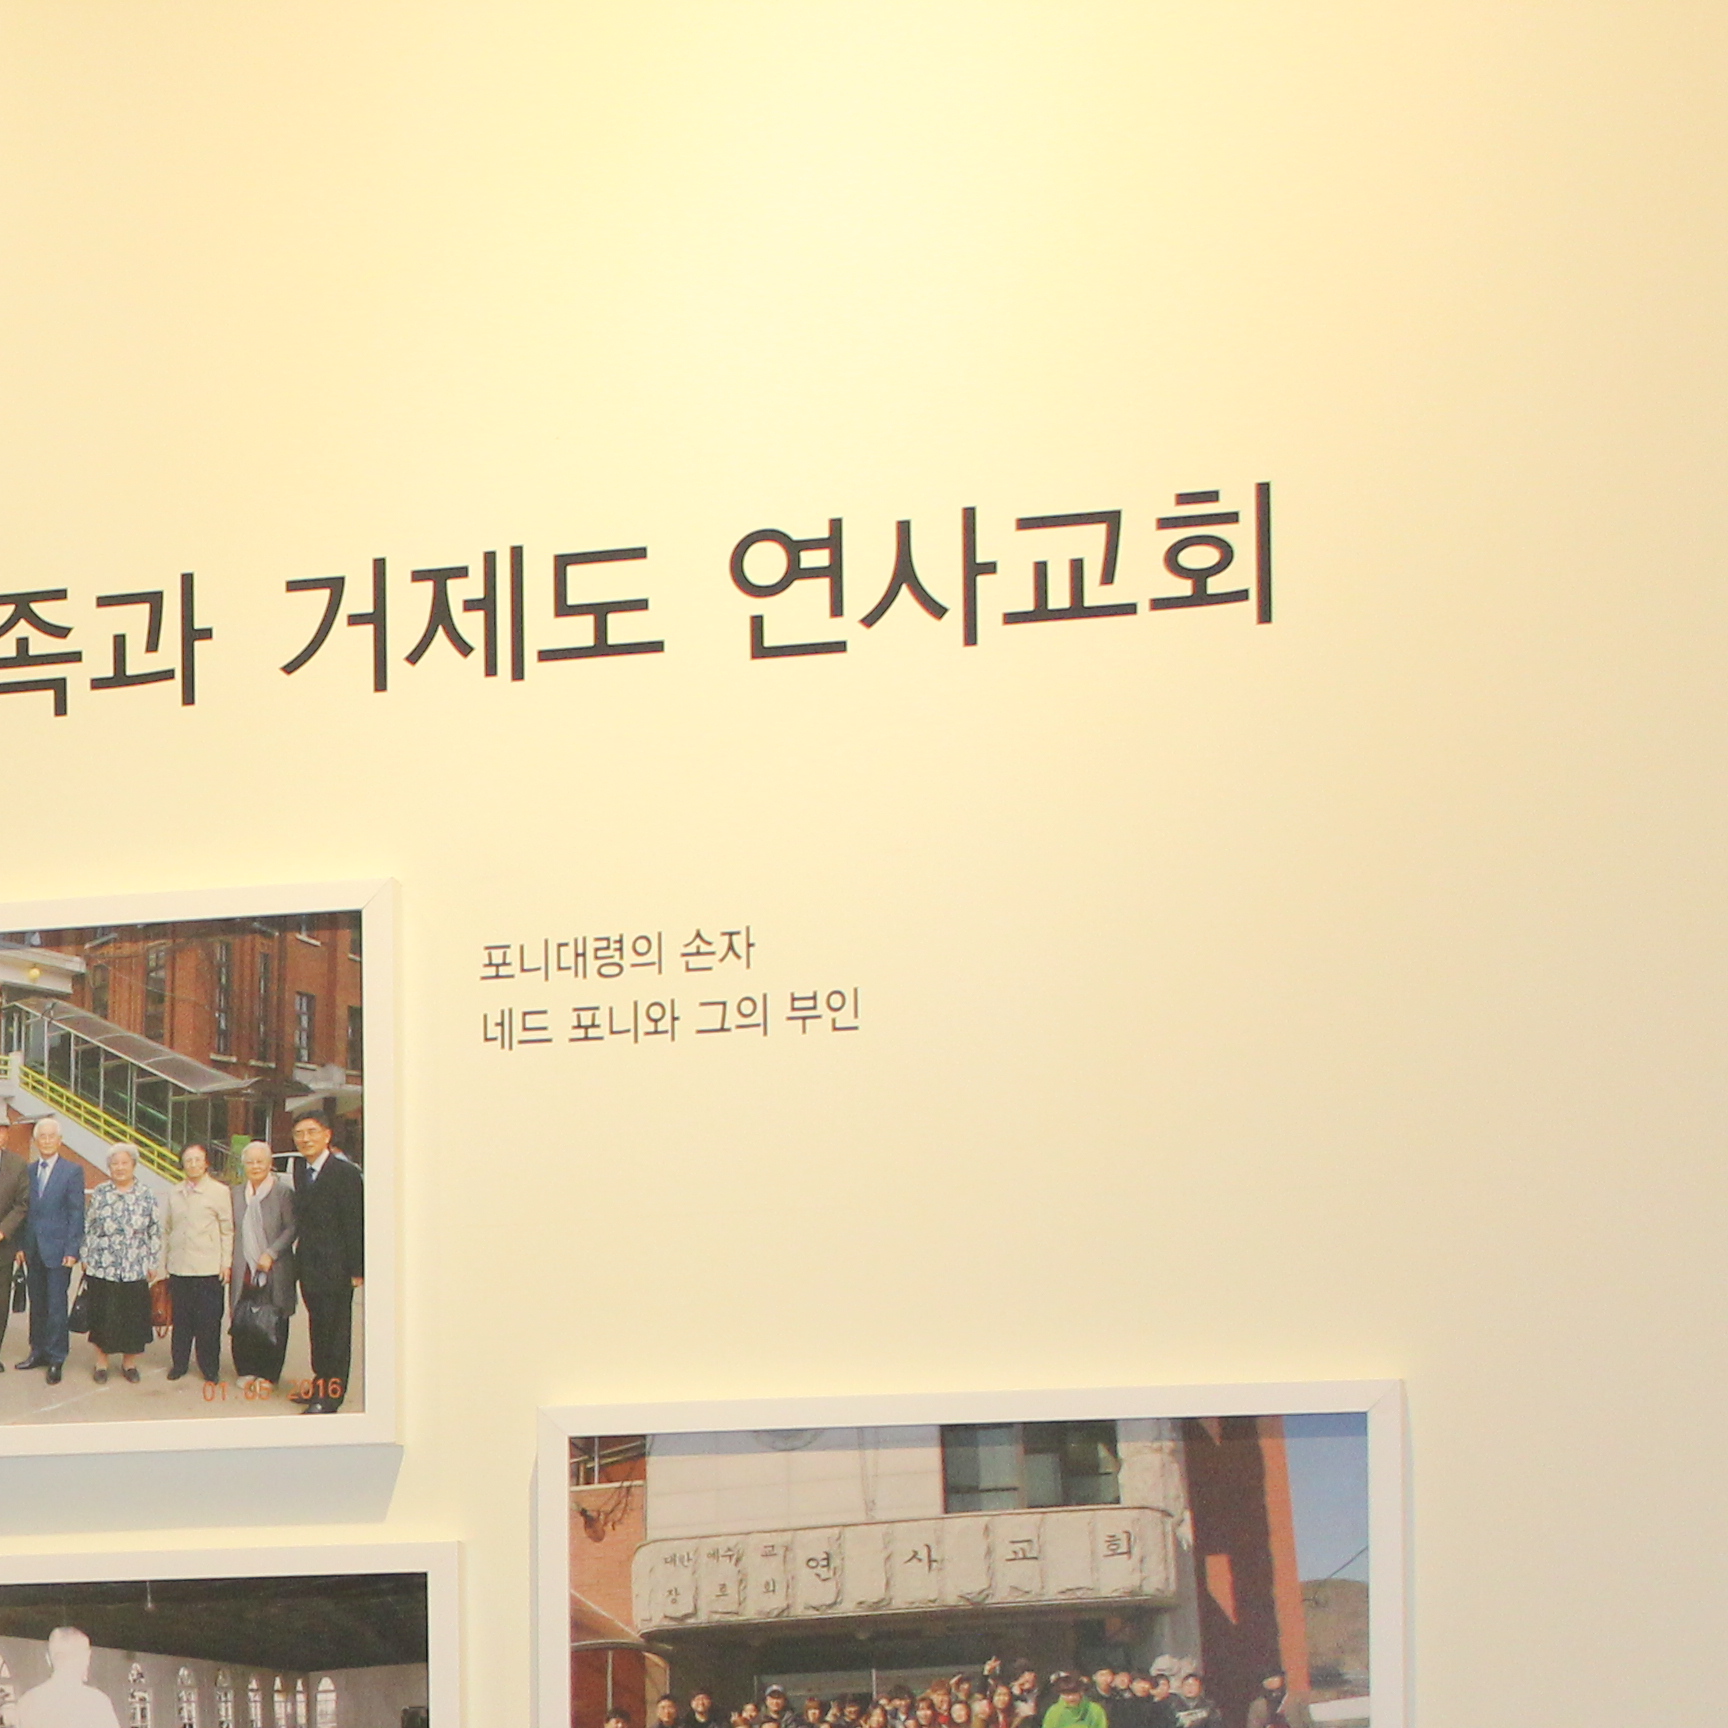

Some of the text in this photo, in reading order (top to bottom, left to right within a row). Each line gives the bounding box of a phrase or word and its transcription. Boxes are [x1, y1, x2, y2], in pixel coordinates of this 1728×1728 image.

[278, 544, 665, 692] 거제도
[728, 481, 1277, 661] 연사교회
[479, 925, 756, 981] 포니대령의 손자
[482, 987, 860, 1051] 네드 포니와 그의 부인
